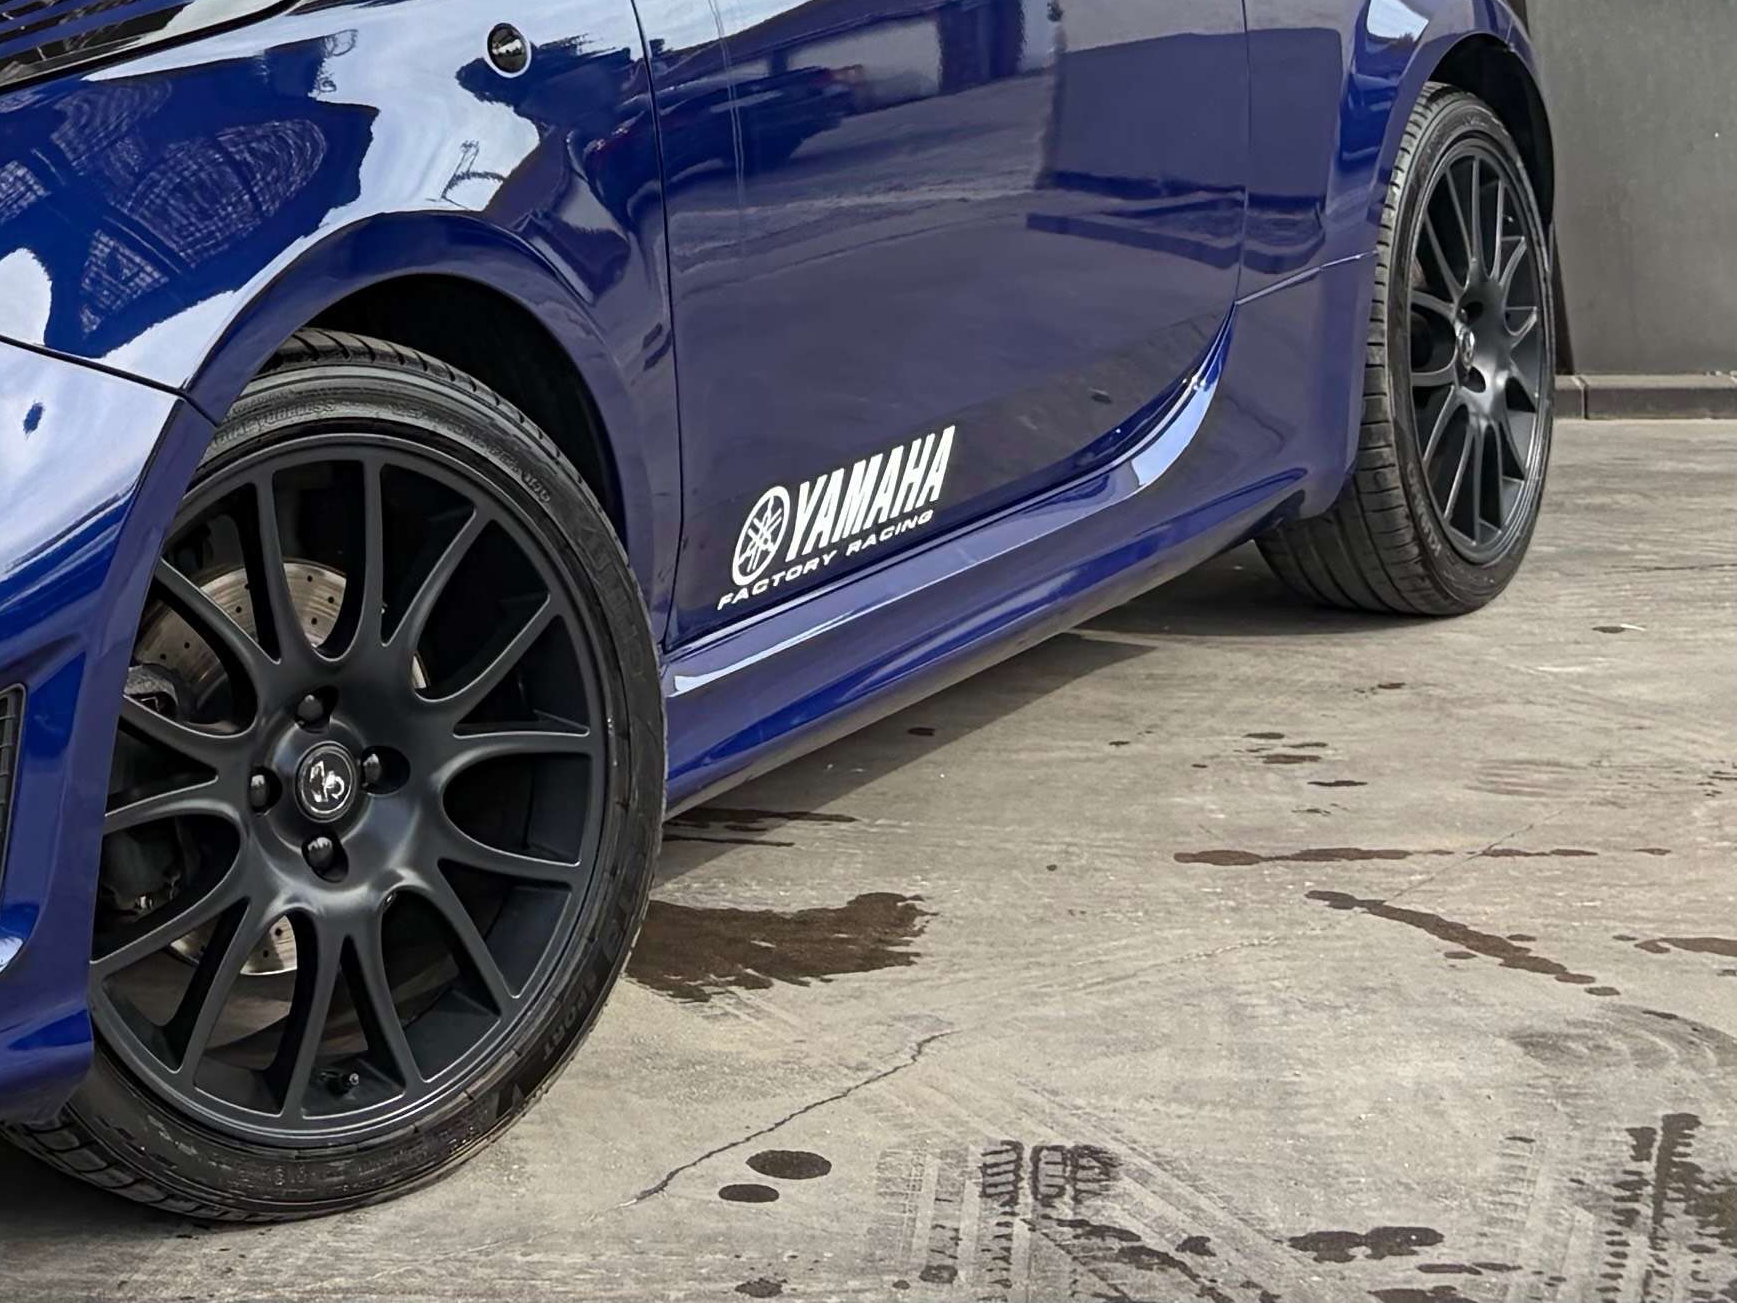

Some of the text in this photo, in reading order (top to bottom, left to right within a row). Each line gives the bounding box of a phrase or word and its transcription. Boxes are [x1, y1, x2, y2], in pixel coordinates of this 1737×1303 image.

[785, 425, 955, 563] YAMAHA
[717, 509, 934, 610] FACTORY RACING
